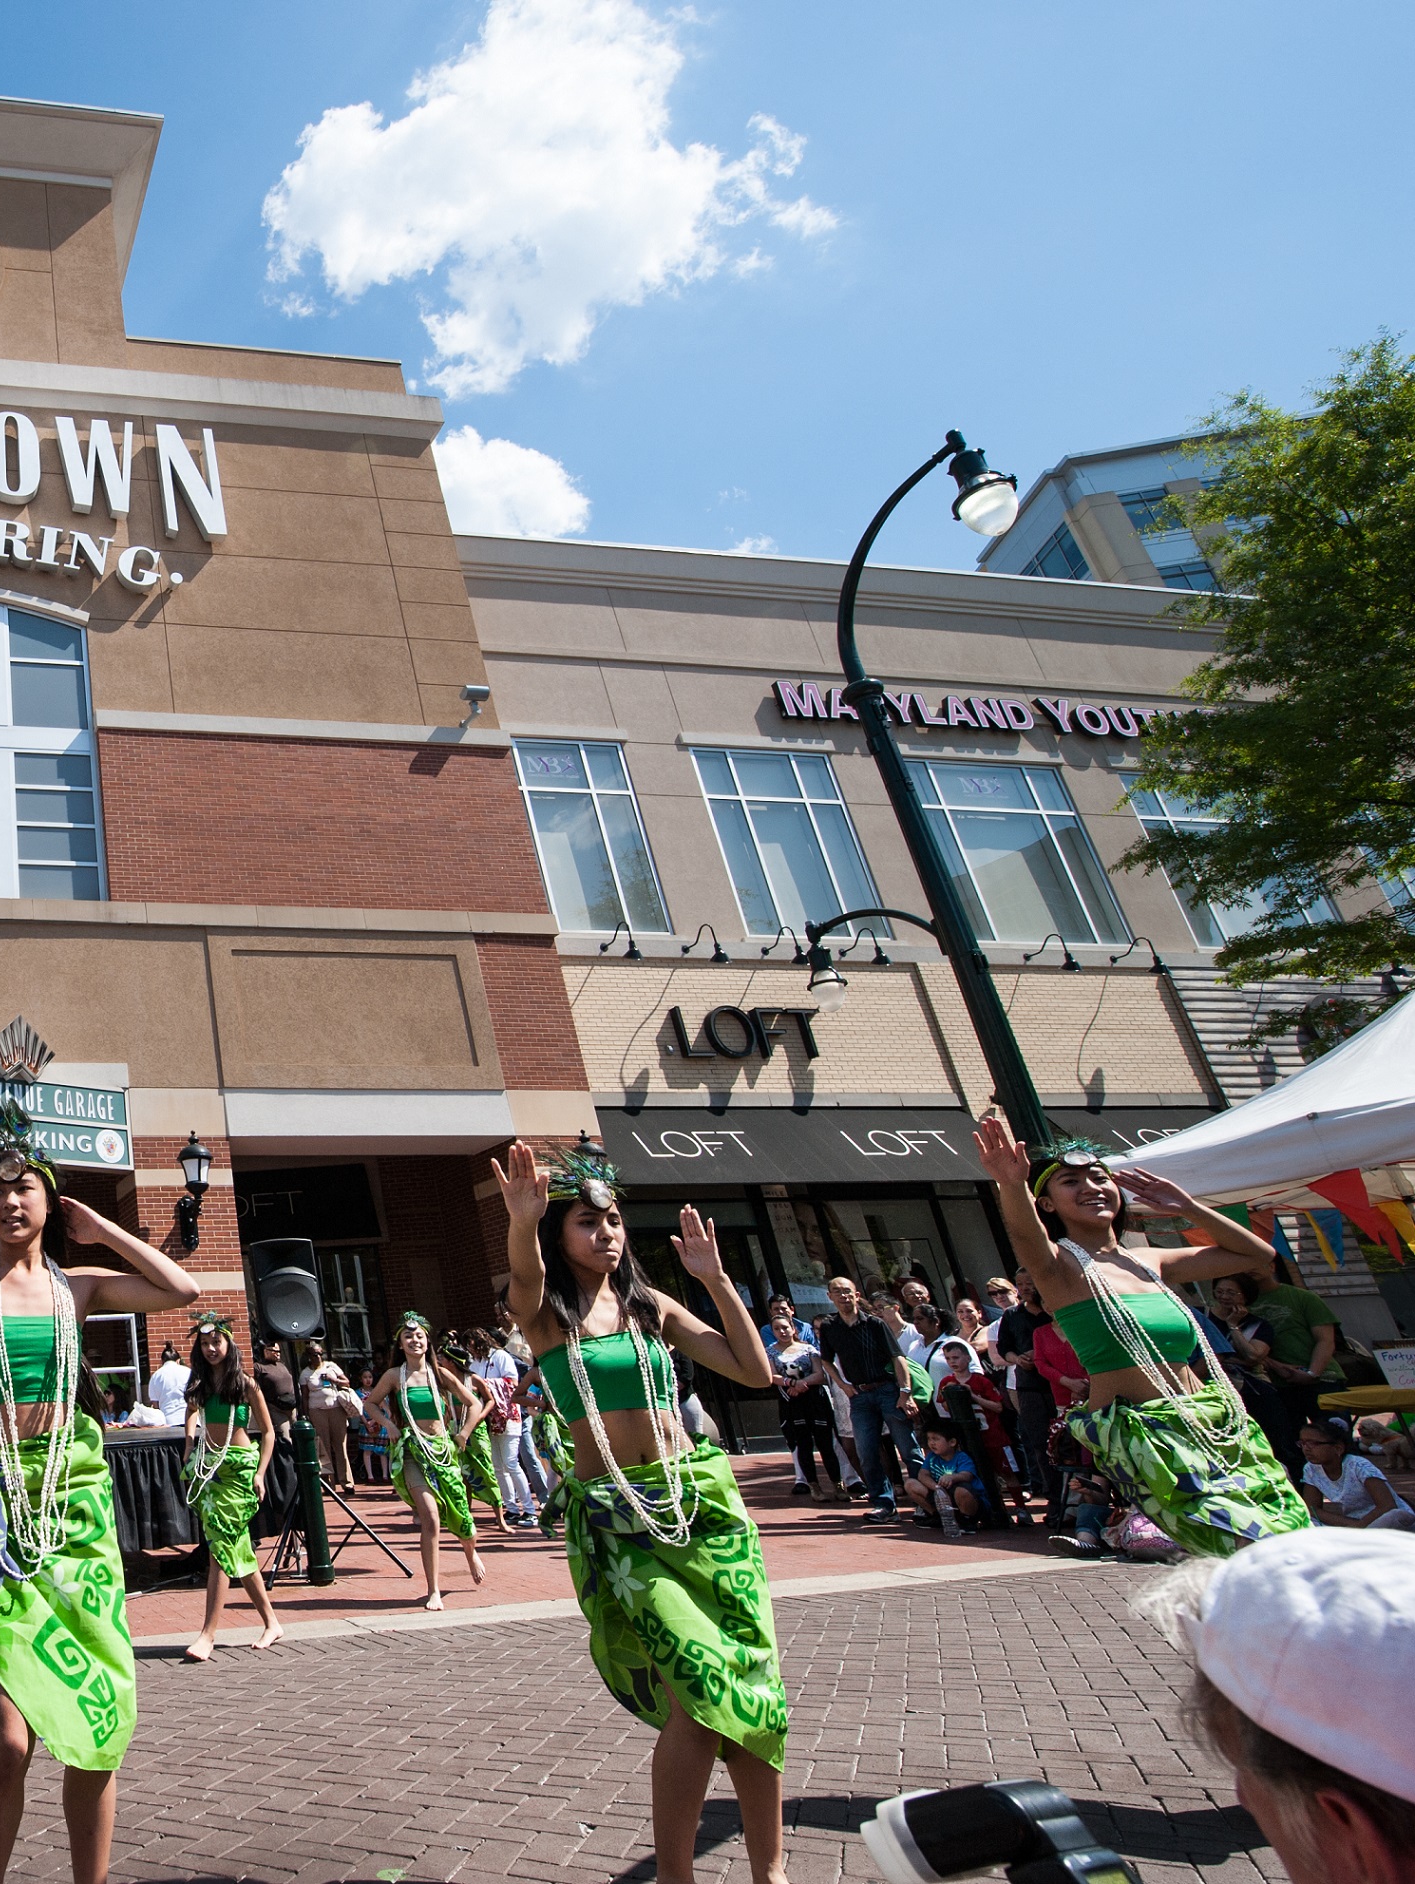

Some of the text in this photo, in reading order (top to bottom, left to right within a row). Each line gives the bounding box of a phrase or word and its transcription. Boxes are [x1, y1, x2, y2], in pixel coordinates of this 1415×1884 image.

[774, 680, 1035, 732] MAYLAND
[667, 1006, 820, 1060] LOFT
[54, 1089, 115, 1121] GARAGE
[631, 1129, 754, 1158] LOFT
[840, 1129, 959, 1157] LOFT
[1381, 1351, 1415, 1361] Fortu
